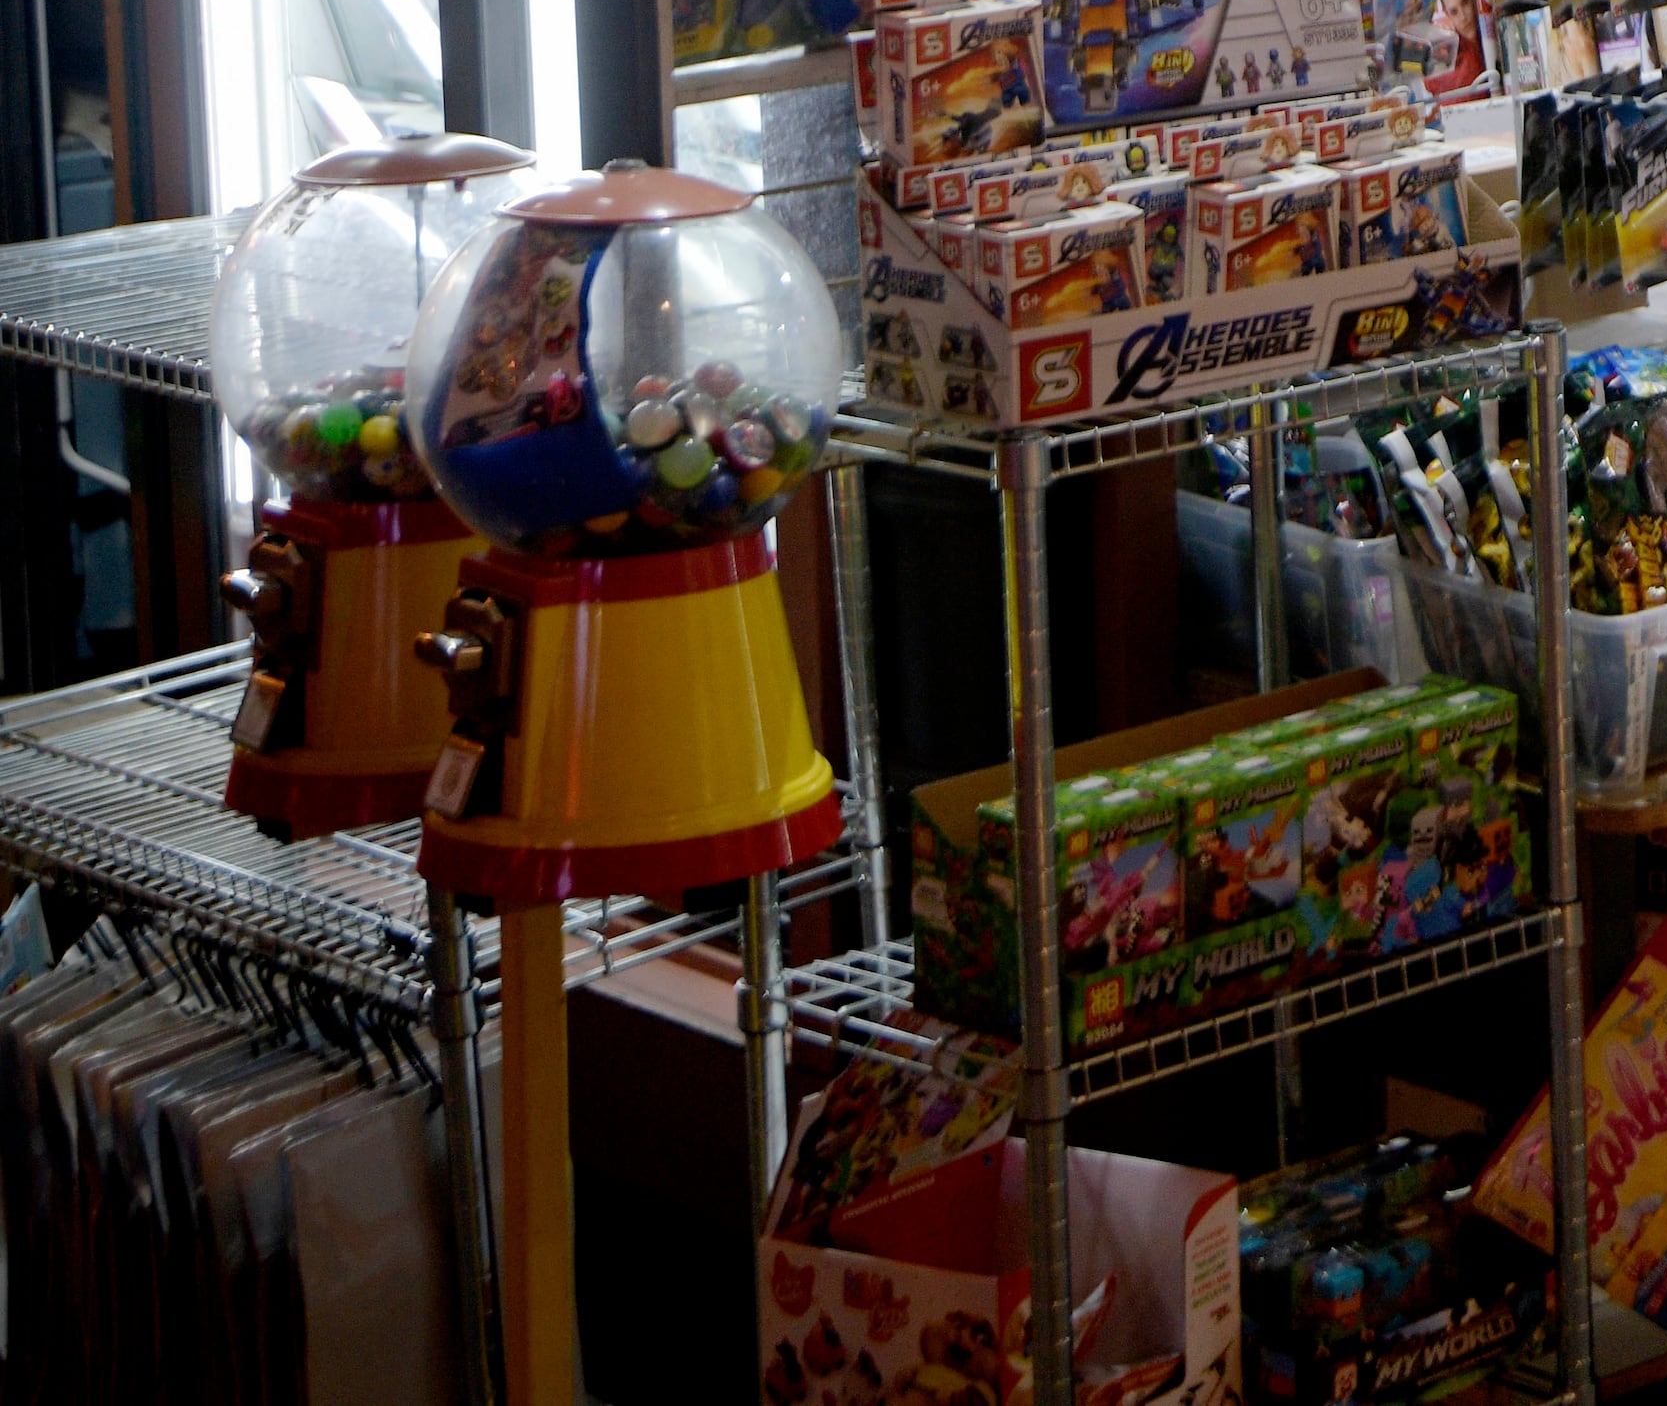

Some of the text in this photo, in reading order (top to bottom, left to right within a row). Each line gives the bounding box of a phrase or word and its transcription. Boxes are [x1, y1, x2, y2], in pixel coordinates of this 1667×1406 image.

[920, 79, 941, 96] 6+
[1363, 226, 1382, 241] 6+
[1184, 305, 1314, 346] HEROES
[1133, 928, 1297, 1004] MY WORLD
[1372, 1308, 1518, 1390] MY WORLD
